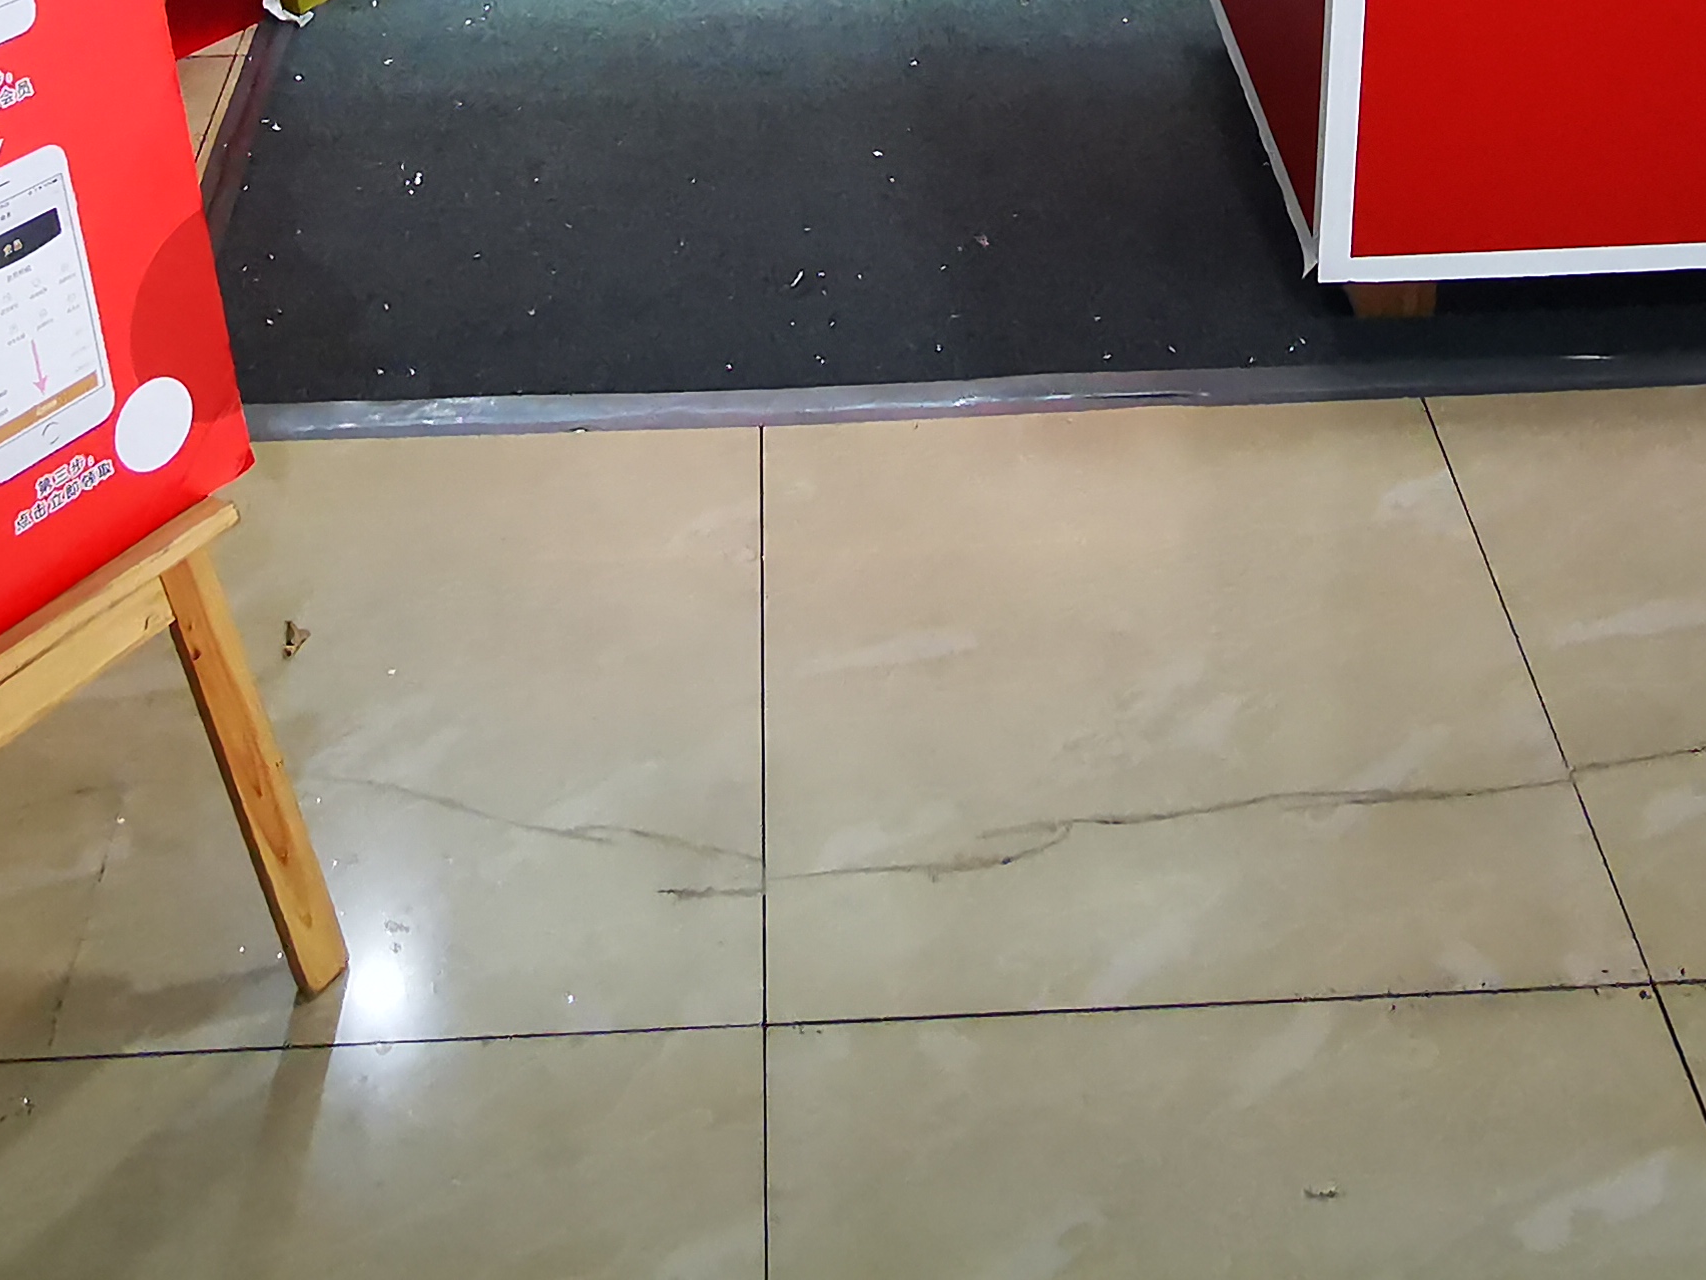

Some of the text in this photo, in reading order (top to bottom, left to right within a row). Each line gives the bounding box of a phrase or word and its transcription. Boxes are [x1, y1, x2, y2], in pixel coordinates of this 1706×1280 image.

[14, 459, 113, 534] 点击立即领取
